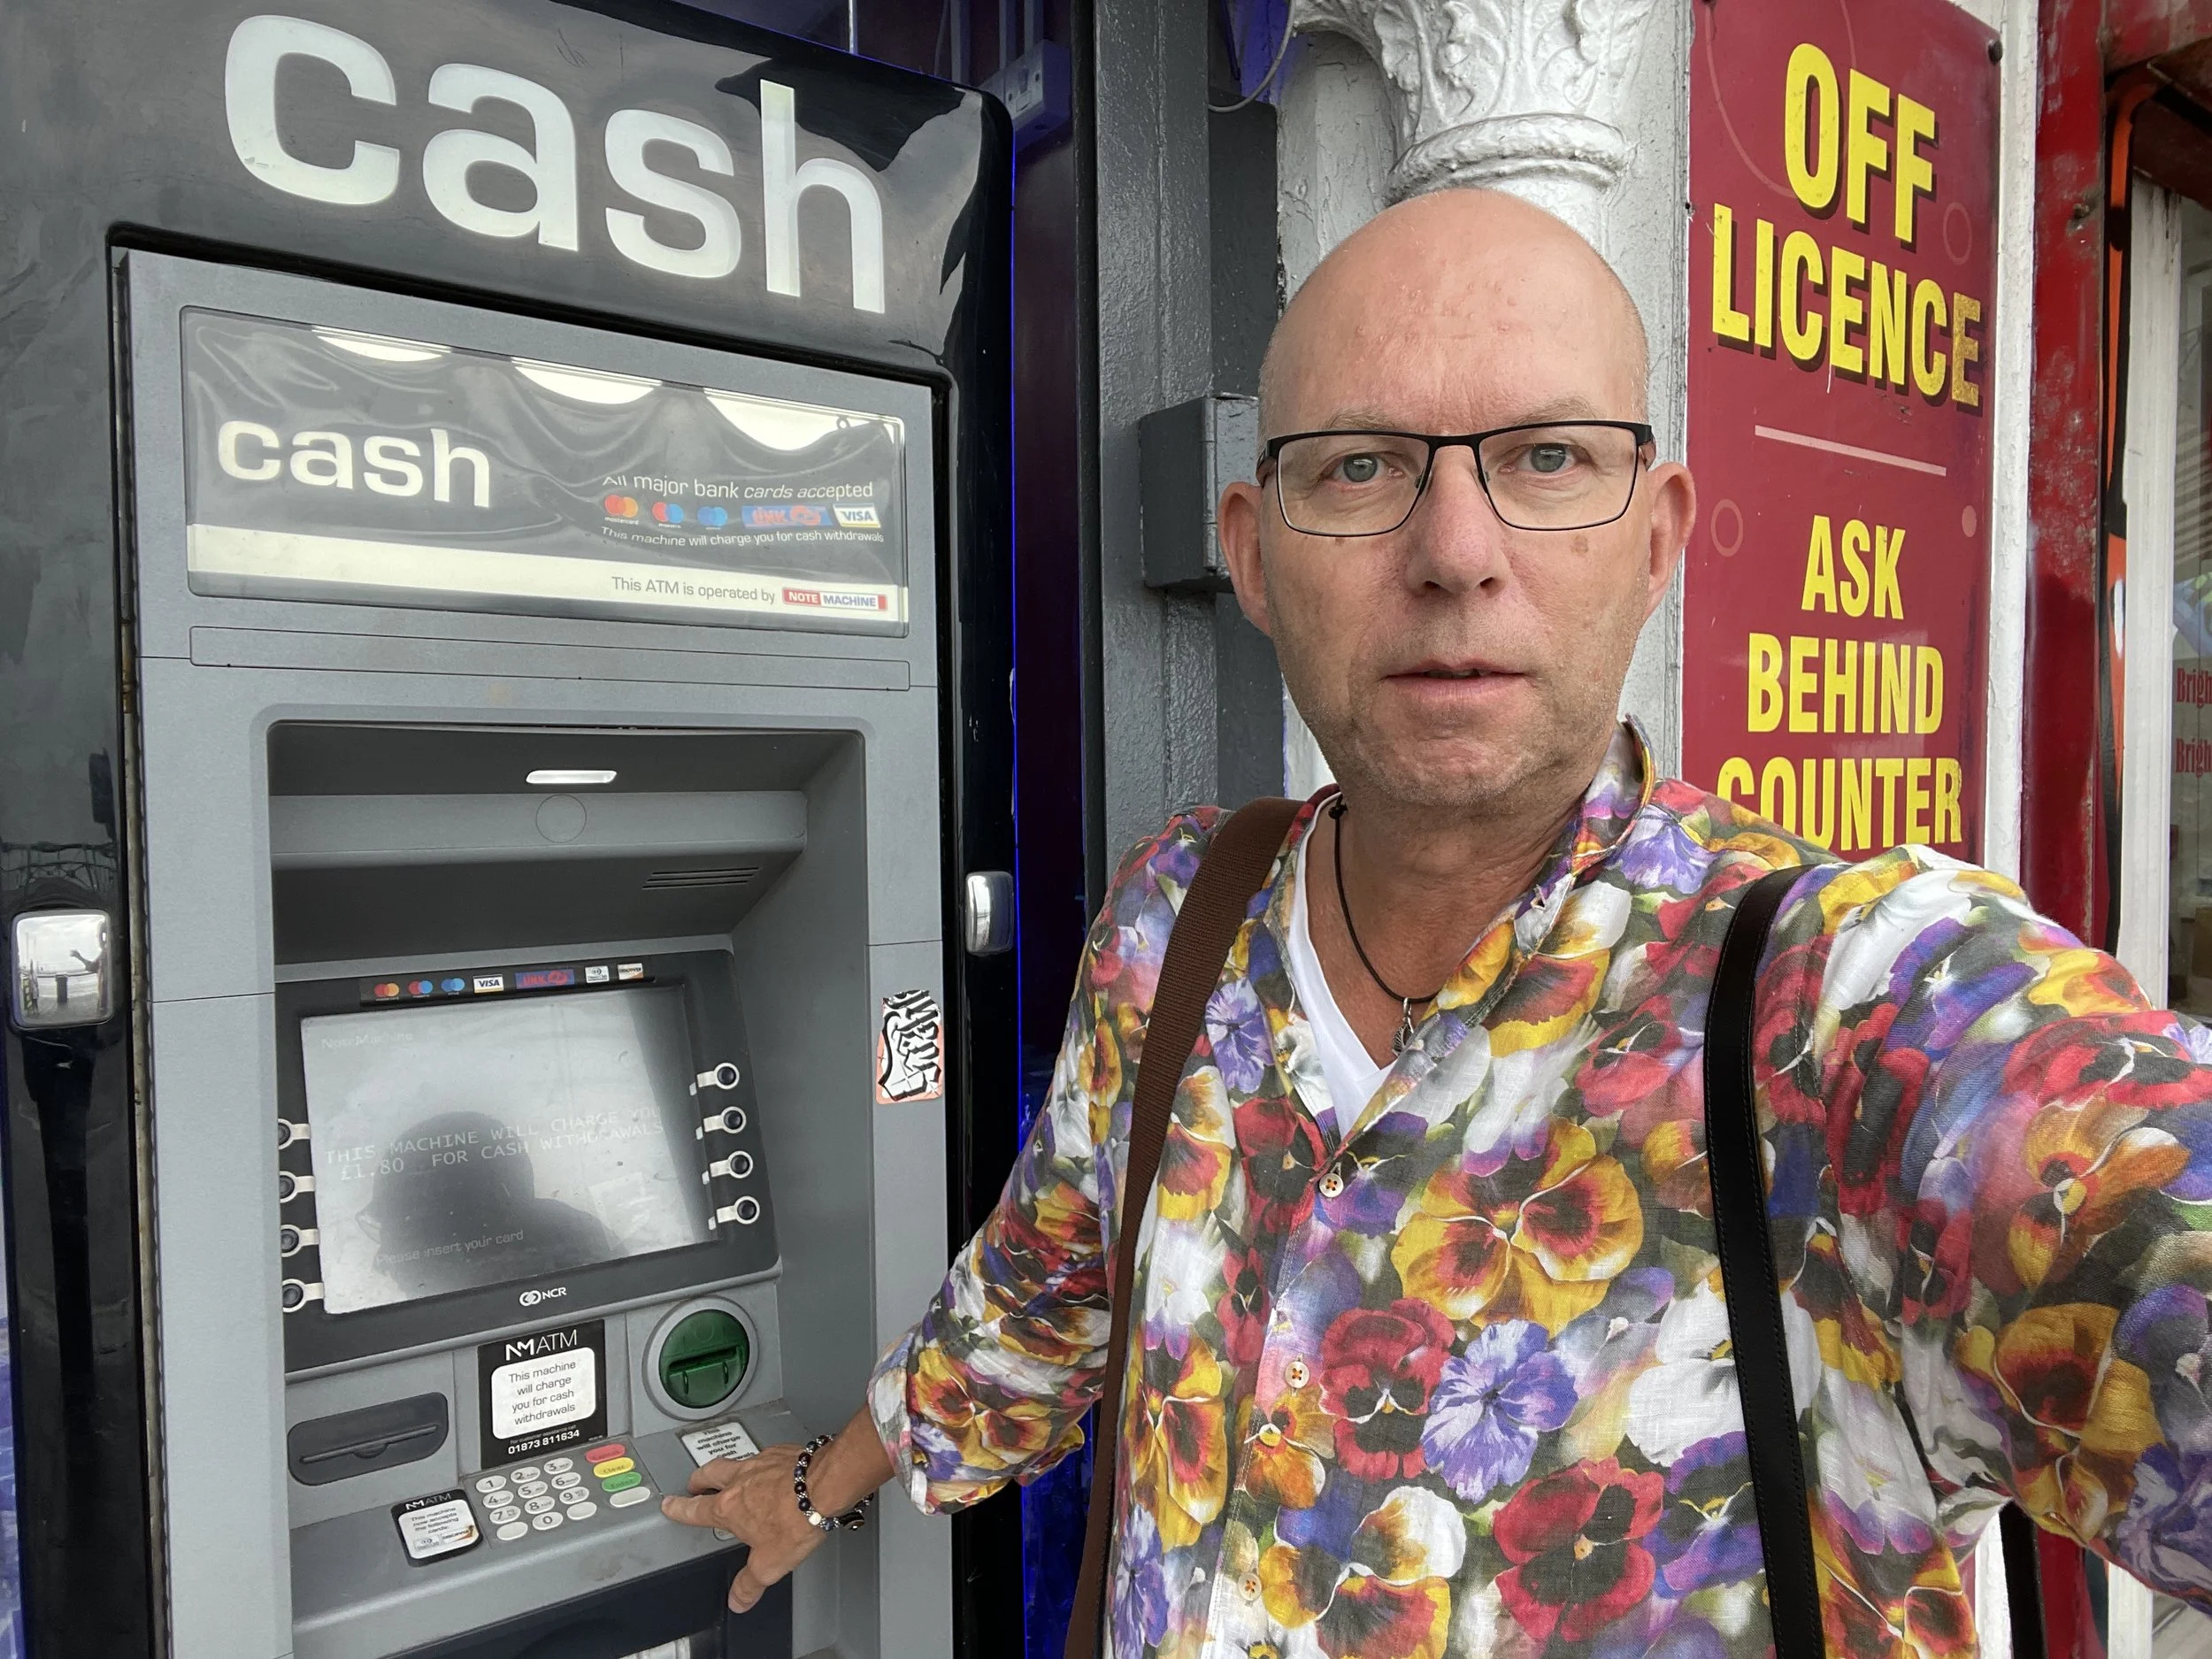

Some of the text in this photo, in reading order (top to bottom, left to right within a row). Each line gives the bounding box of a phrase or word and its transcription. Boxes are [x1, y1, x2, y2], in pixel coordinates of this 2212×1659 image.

[1784, 42, 1936, 244] OFF
[226, 14, 884, 314] cash
[1711, 203, 1982, 407] LICENCE
[218, 420, 490, 508] cash
[603, 475, 873, 501] All major bank cards accepted
[604, 516, 639, 526] mastercard
[841, 511, 874, 522] VISA
[602, 526, 885, 549] This machine will charge you for cash withdrawals
[1801, 513, 1906, 619] ASK
[611, 576, 642, 592] This
[645, 579, 680, 595] ATM
[683, 581, 695, 596] is
[697, 584, 758, 603] operated
[761, 588, 776, 605] by
[788, 591, 818, 603] NOTE
[1747, 632, 1946, 736] BEHIND
[477, 979, 501, 988] VISA
[326, 1145, 376, 1164] THIS
[389, 1131, 480, 1155] MACHINE
[490, 1125, 539, 1141] WILL
[550, 1111, 618, 1133] CHARGE
[341, 1122, 664, 1181] £1.80 FOR CASH WITHDRAWALS
[425, 1242, 462, 1258] insert
[465, 1235, 492, 1253] your
[495, 1230, 524, 1245] card
[541, 1286, 567, 1300] NCR
[509, 1361, 576, 1383] This machine
[517, 1376, 572, 1395] will charge
[511, 1389, 574, 1413] you for cash
[514, 1403, 575, 1425] withdrawals
[508, 1429, 580, 1455] 01873 811634
[708, 1447, 724, 1455] you
[712, 1435, 741, 1448] charge
[514, 1471, 523, 1480] 2
[546, 1463, 557, 1471] 3
[521, 1486, 531, 1495] 5
[556, 1477, 565, 1486] 6
[488, 1495, 498, 1504] 4
[529, 1502, 540, 1510] 8
[564, 1492, 573, 1501] 9
[494, 1510, 503, 1520] 7
[542, 1516, 553, 1525] 0
